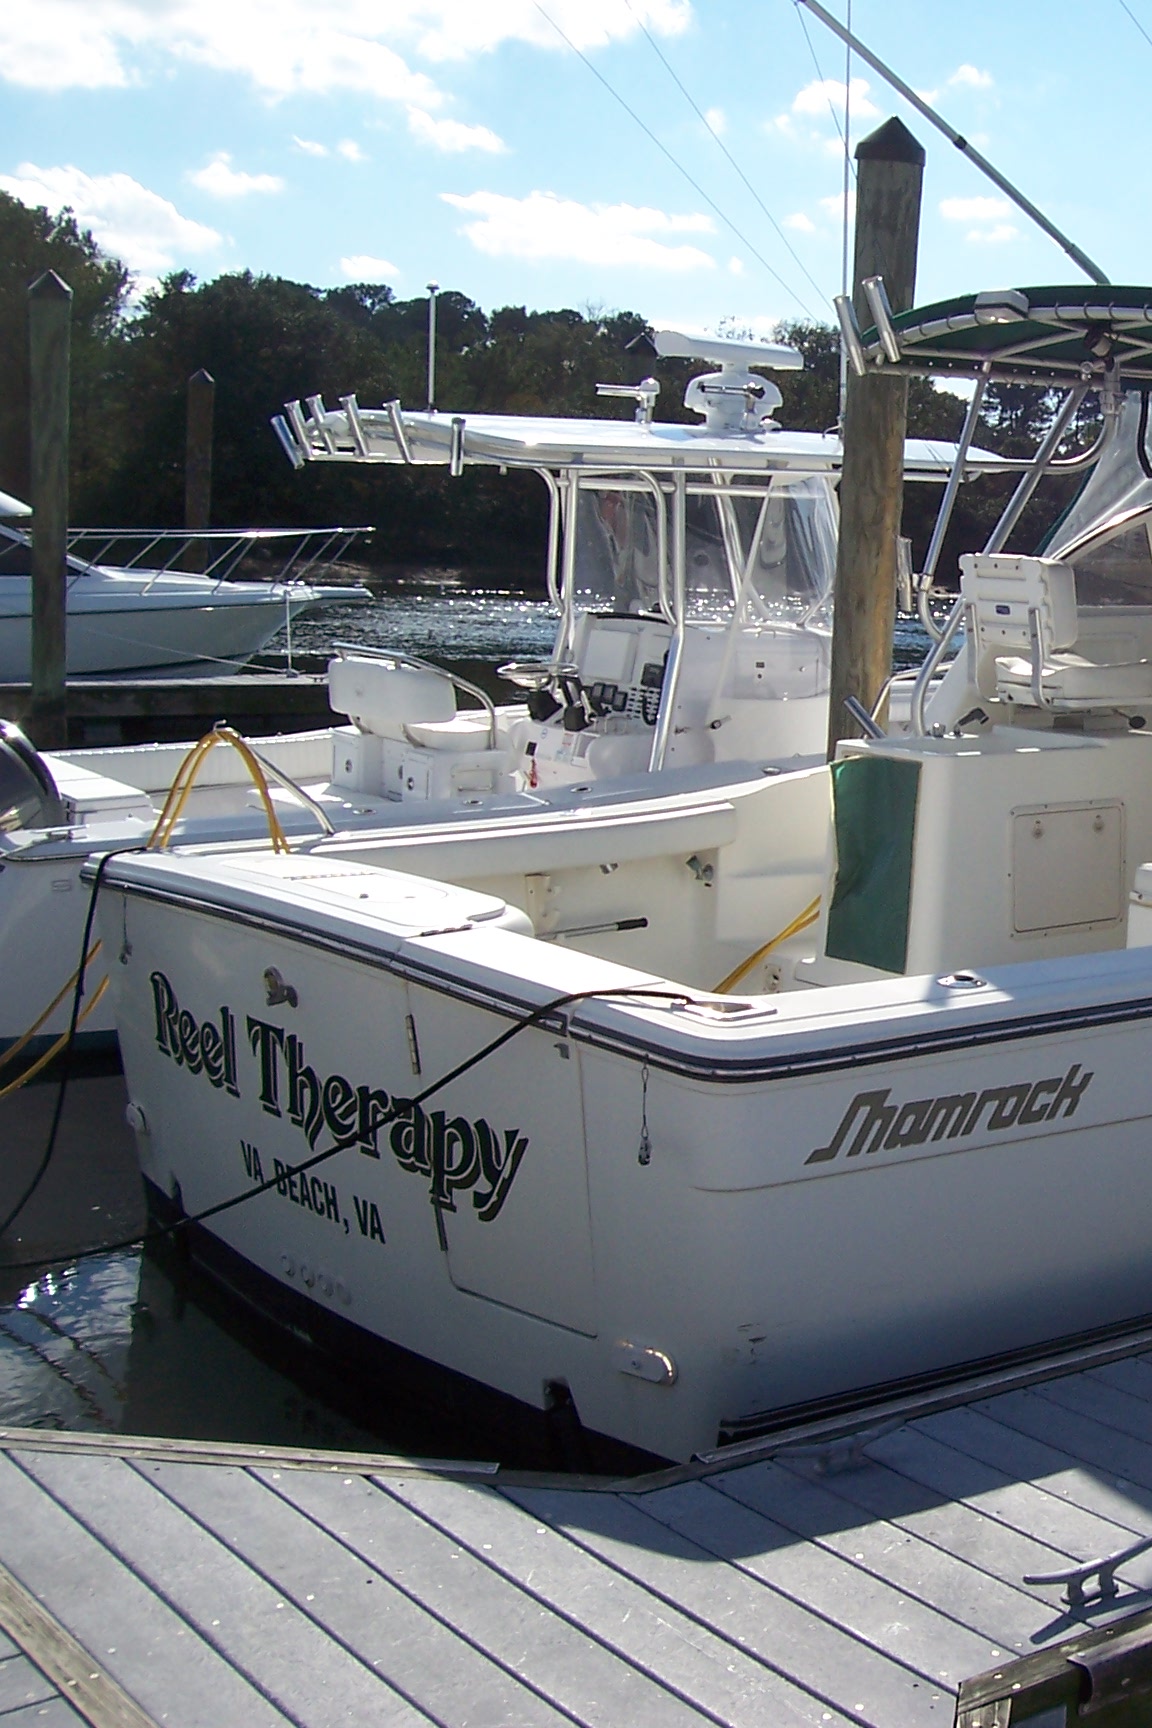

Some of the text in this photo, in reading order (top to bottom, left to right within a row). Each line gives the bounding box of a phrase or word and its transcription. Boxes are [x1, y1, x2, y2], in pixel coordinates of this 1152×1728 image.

[150, 971, 530, 1222] Reel Therapy
[803, 1063, 1094, 1165] Shamrock
[240, 1139, 265, 1185] VA
[353, 1195, 386, 1245] VA
